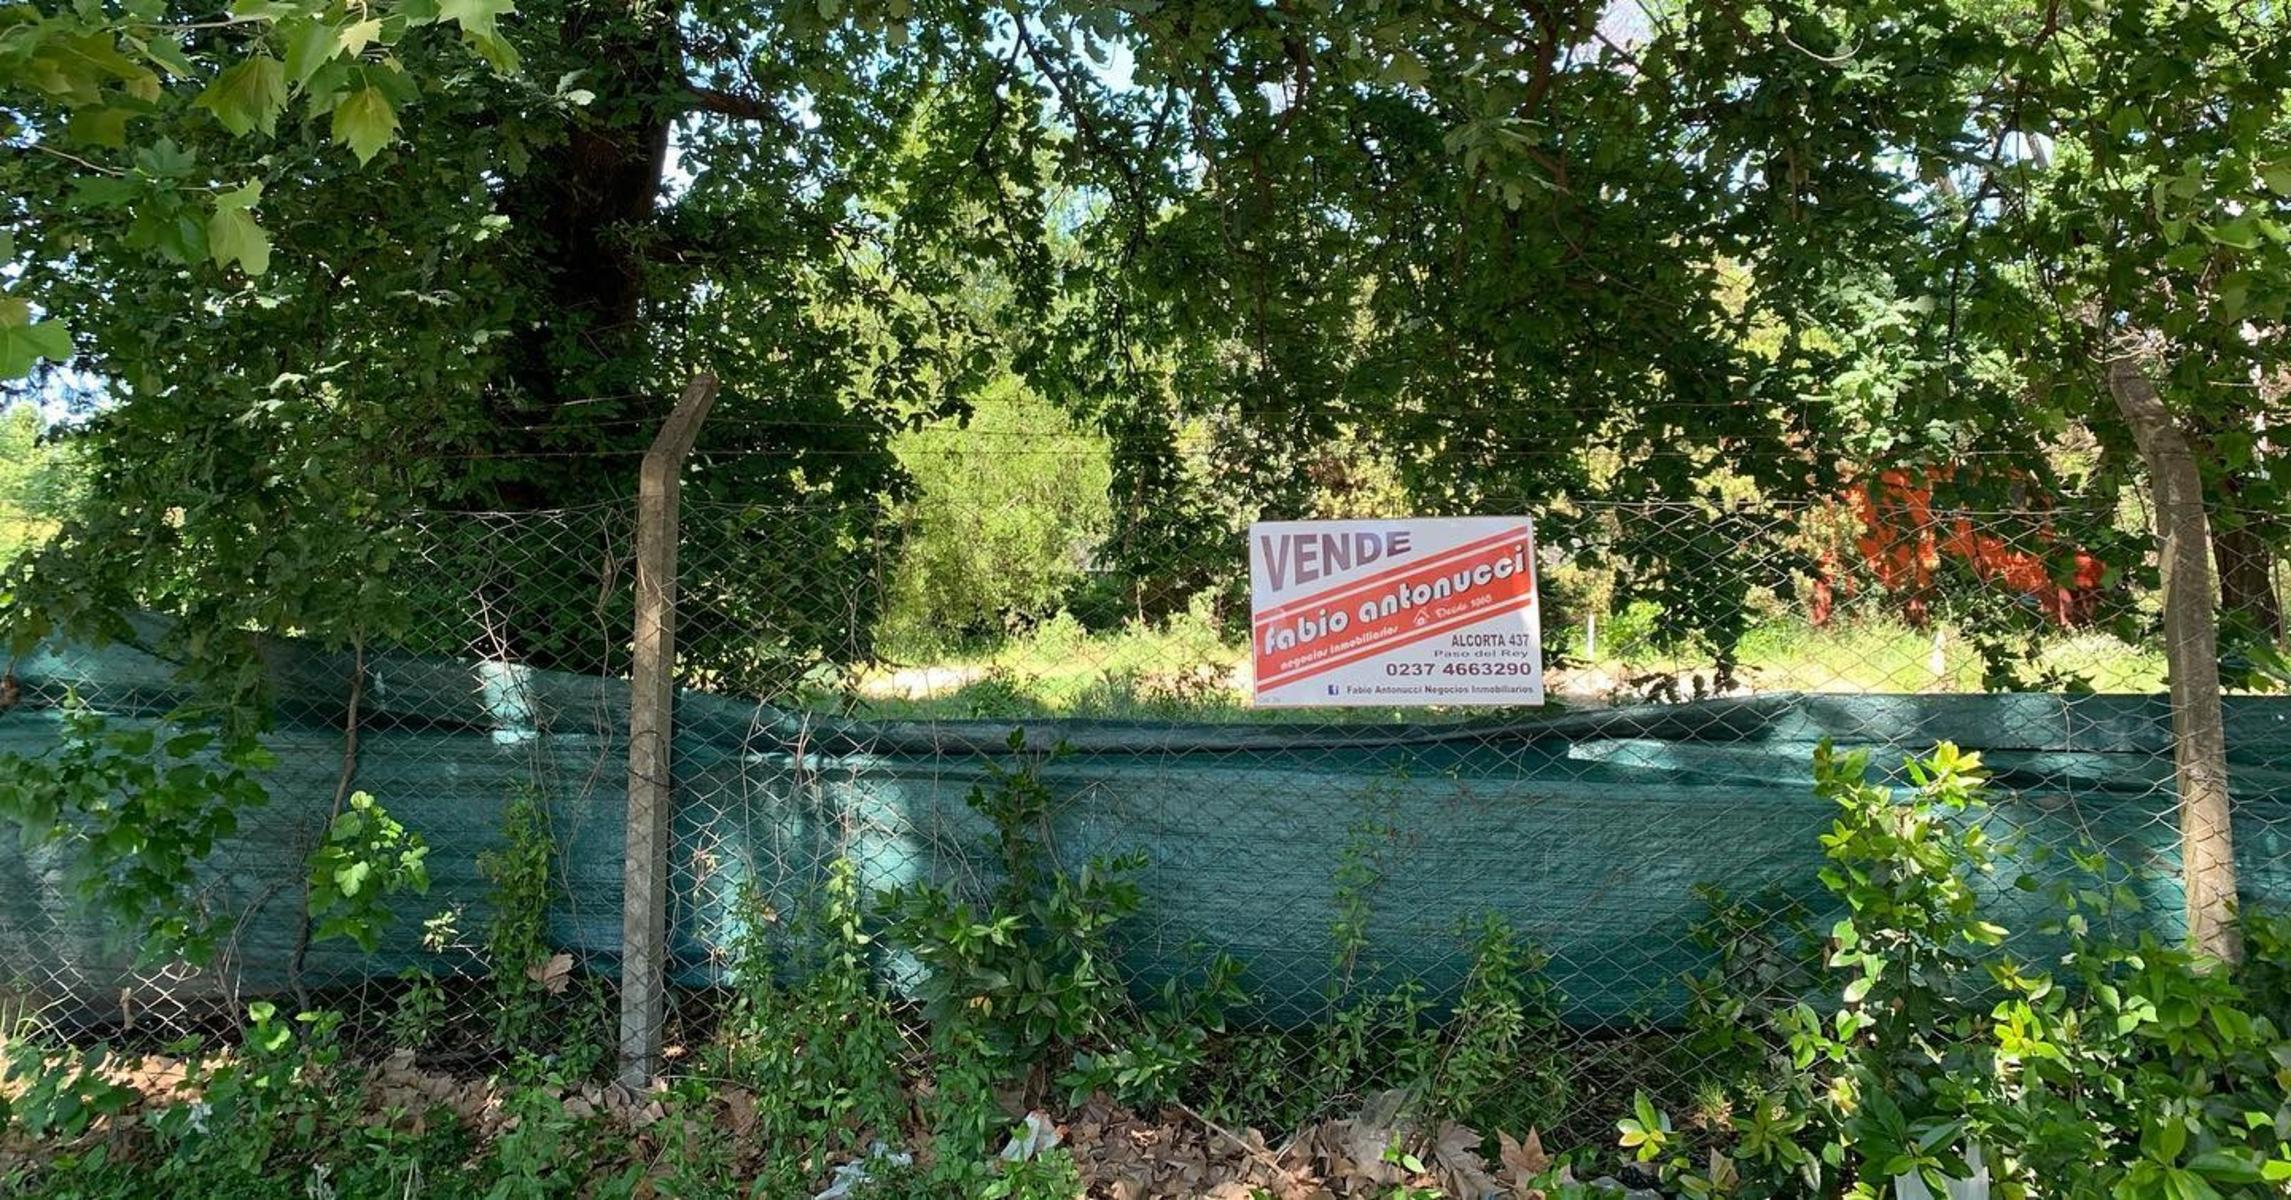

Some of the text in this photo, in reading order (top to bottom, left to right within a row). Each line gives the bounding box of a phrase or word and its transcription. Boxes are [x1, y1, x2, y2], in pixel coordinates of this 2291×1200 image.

[1261, 531, 1412, 592] VENDE
[1264, 545, 1525, 656] fabio antonucci
[1451, 634, 1530, 647] ALCORTA 437
[1280, 626, 1398, 671] negocios inmobiliarios
[1434, 649, 1529, 659] Paso del Rey
[1386, 663, 1532, 676] 0237 4663290
[1347, 685, 1372, 694] Fabio
[1375, 685, 1422, 694] Antonucci
[1424, 685, 1468, 696] Negocios
[1471, 685, 1534, 694] Inmobiliarios
